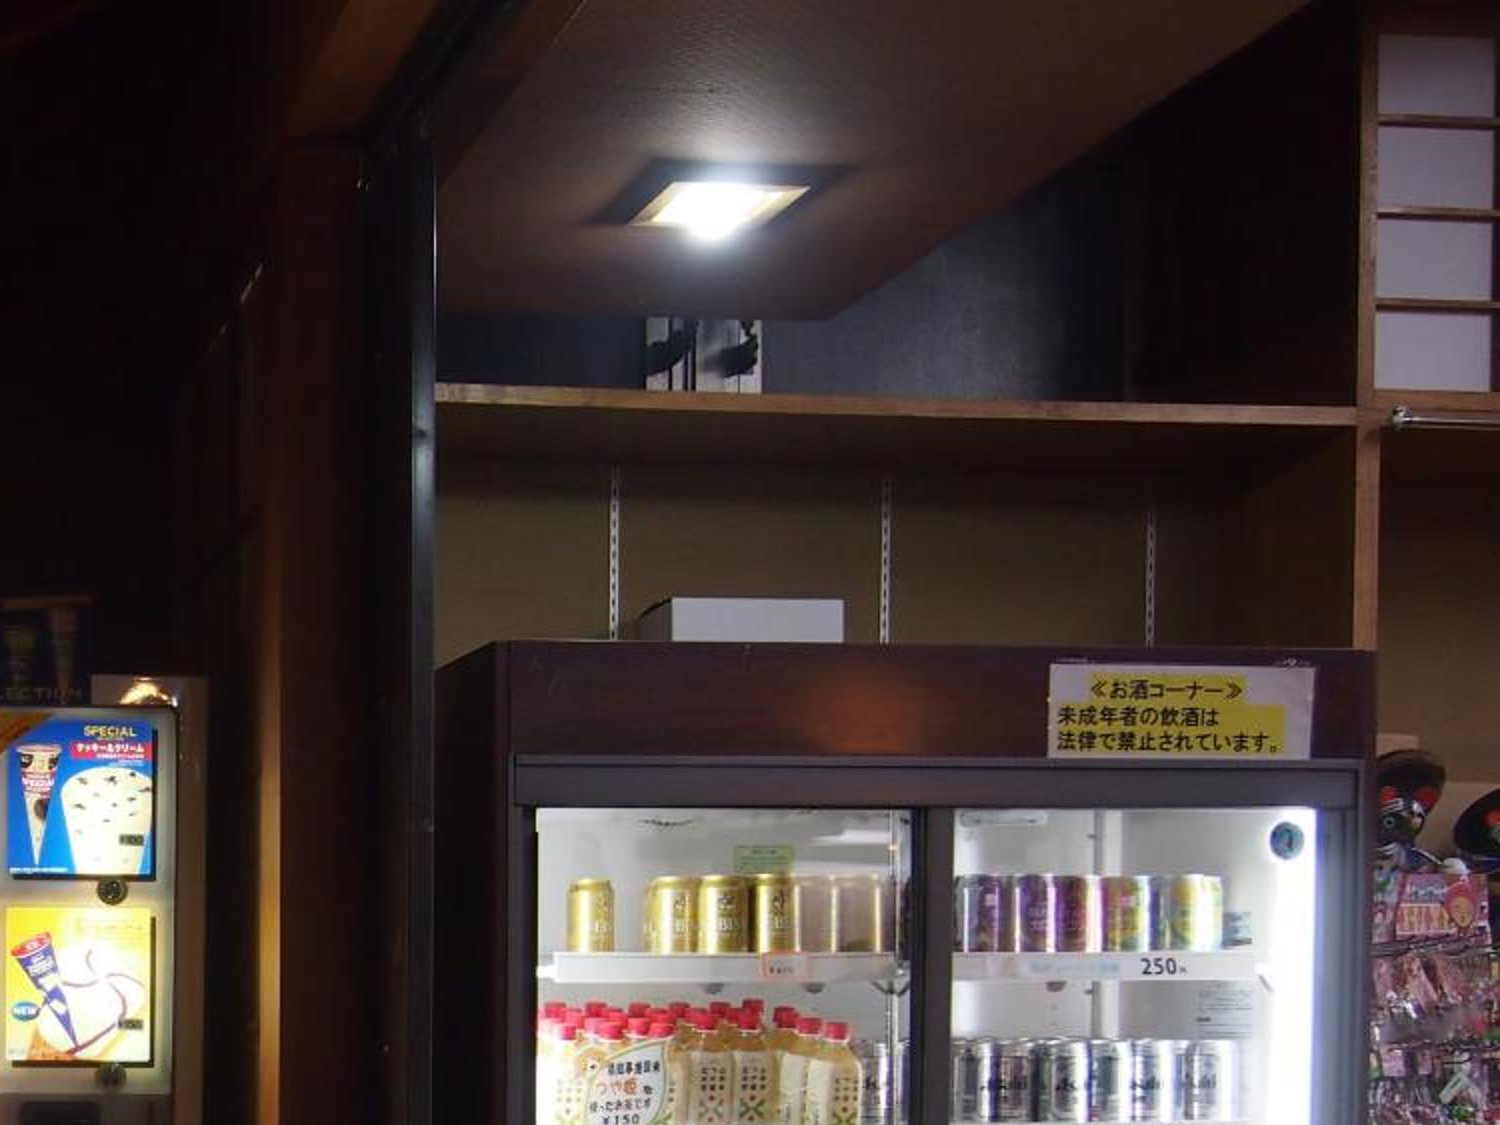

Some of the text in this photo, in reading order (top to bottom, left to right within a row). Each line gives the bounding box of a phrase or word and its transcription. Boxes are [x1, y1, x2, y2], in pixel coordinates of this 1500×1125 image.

[1058, 706, 1221, 728] 未成年者の飲酒は
[83, 725, 138, 738] SPECIAL
[1057, 733, 1278, 754] 法律で禁止されています。
